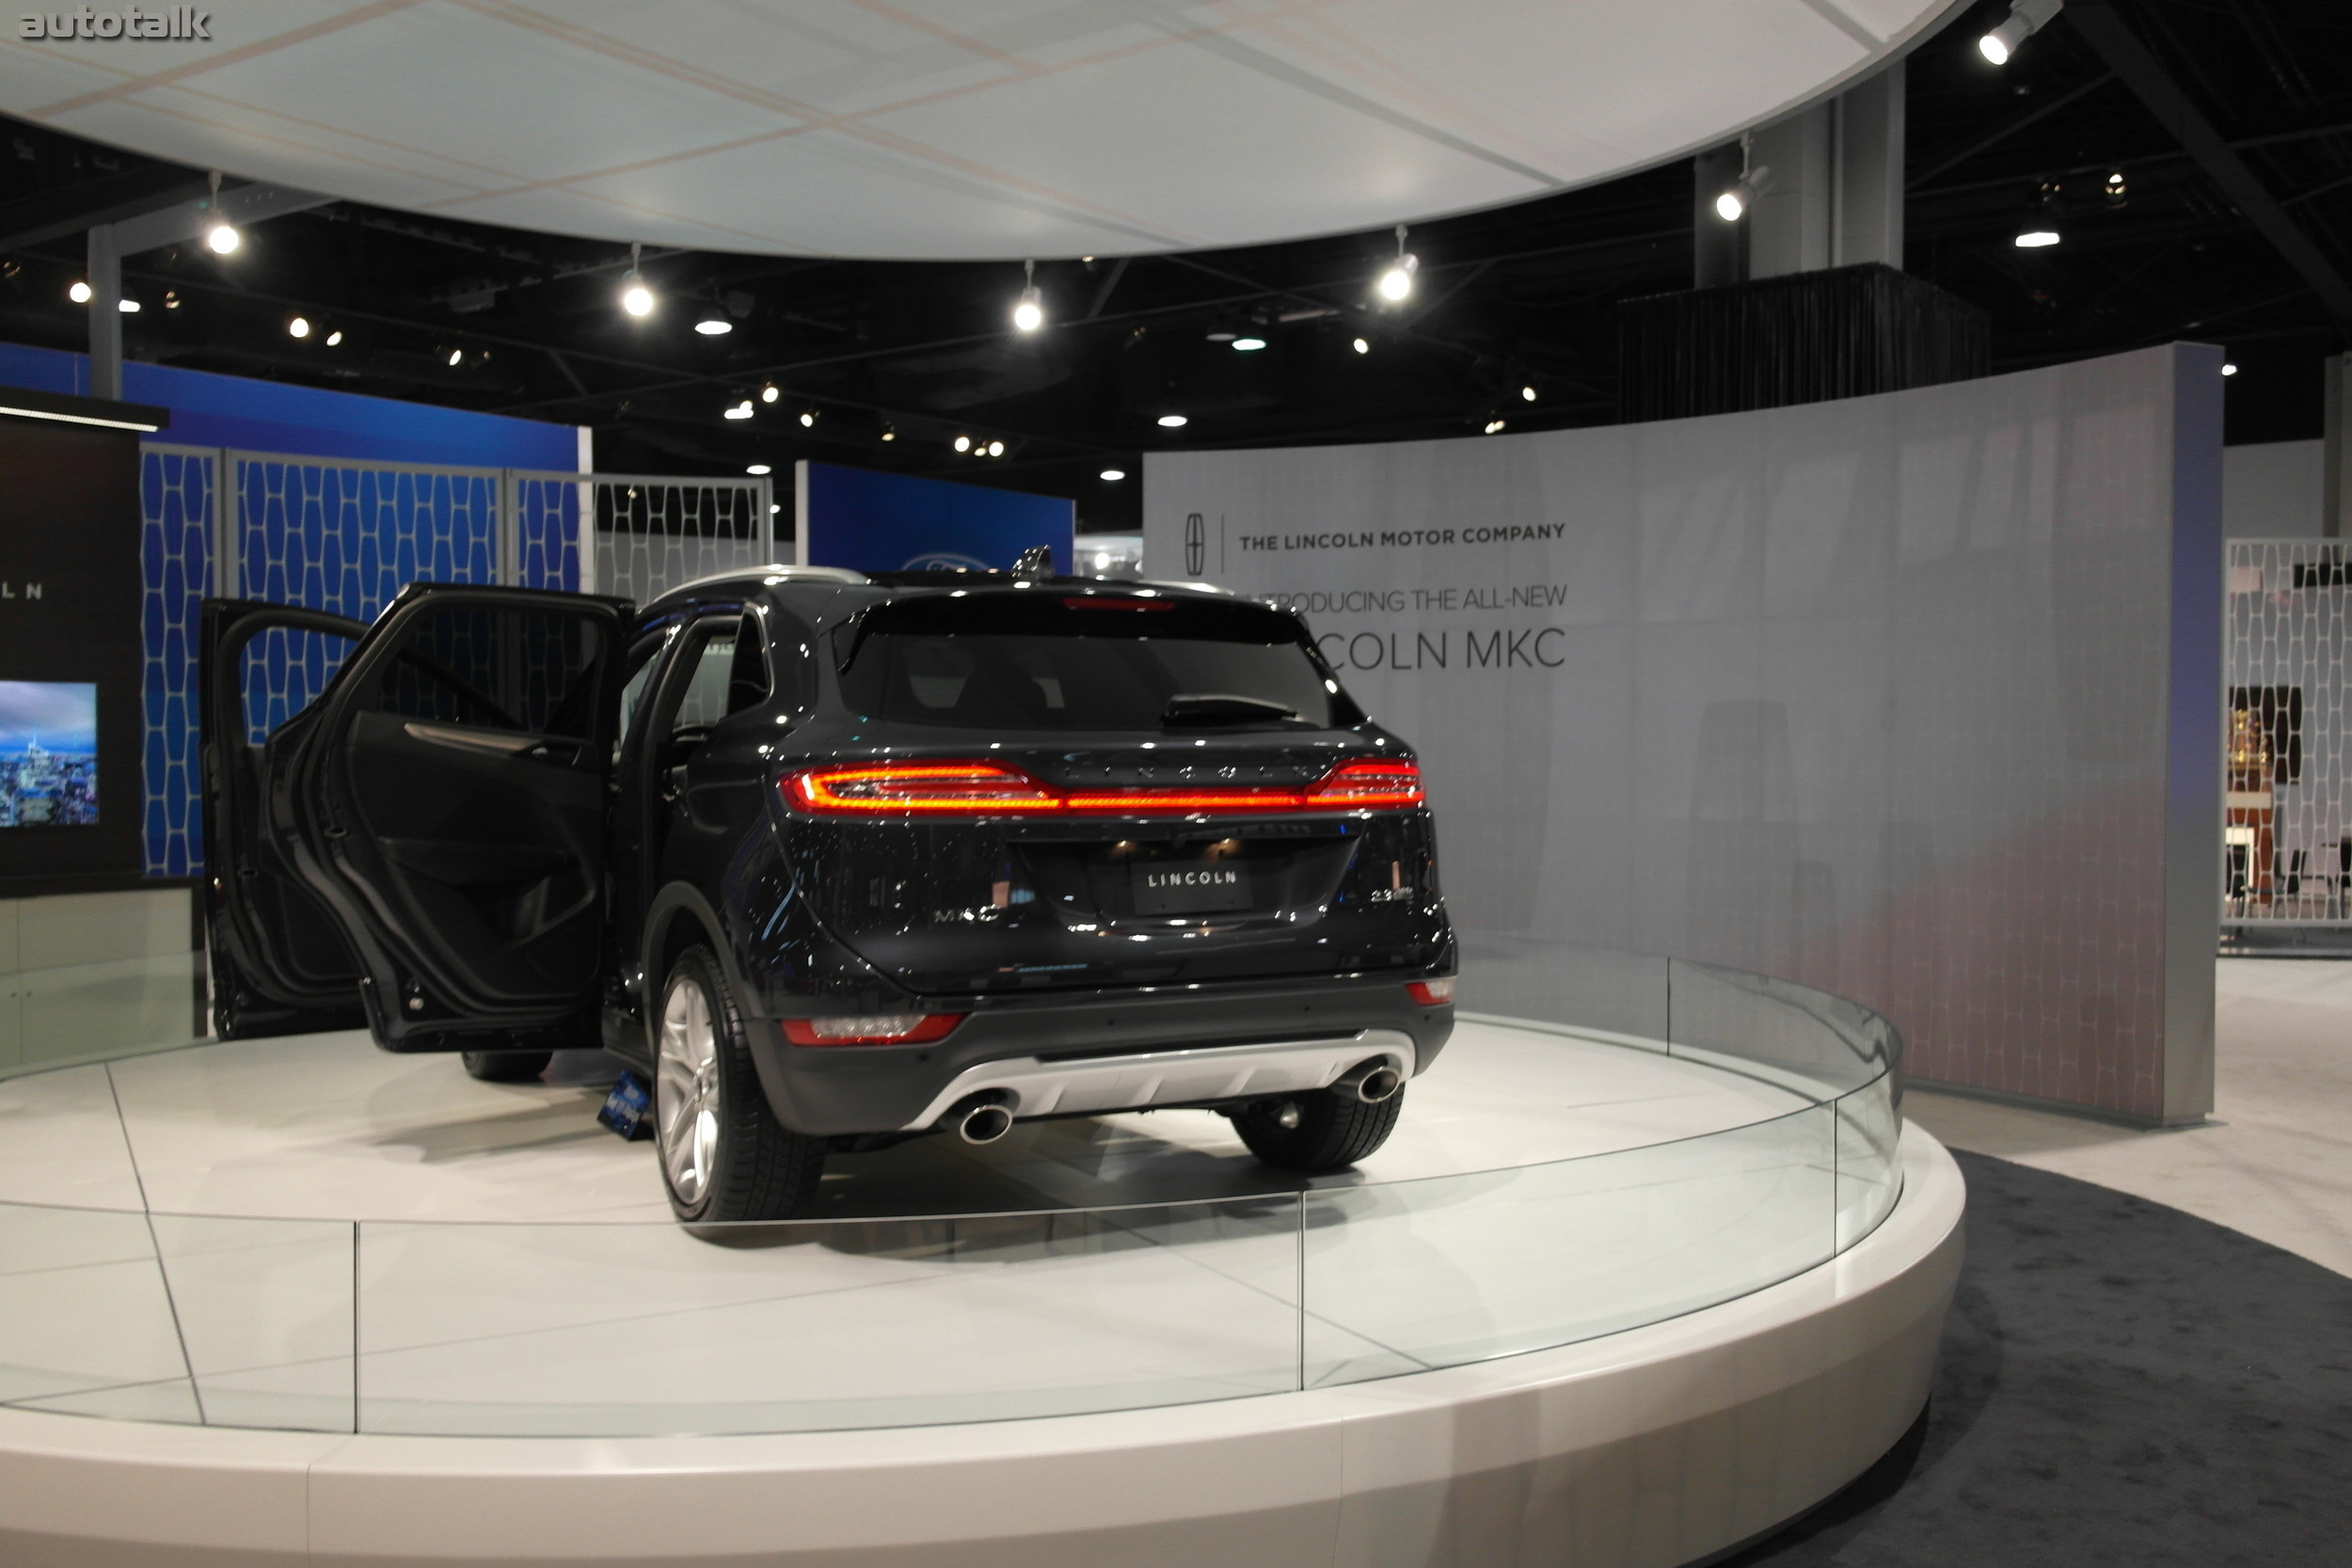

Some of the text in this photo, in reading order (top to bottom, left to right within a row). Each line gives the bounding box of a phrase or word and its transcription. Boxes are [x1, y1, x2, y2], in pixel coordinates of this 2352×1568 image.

[1239, 523, 1566, 551] THE LINCOLN MOTOR COMPANY
[1410, 588, 1457, 610] THE
[1463, 584, 1567, 609] ALL-NEW
[1317, 627, 1566, 671] COLN MKC
[1147, 870, 1237, 888] LINCOLN
